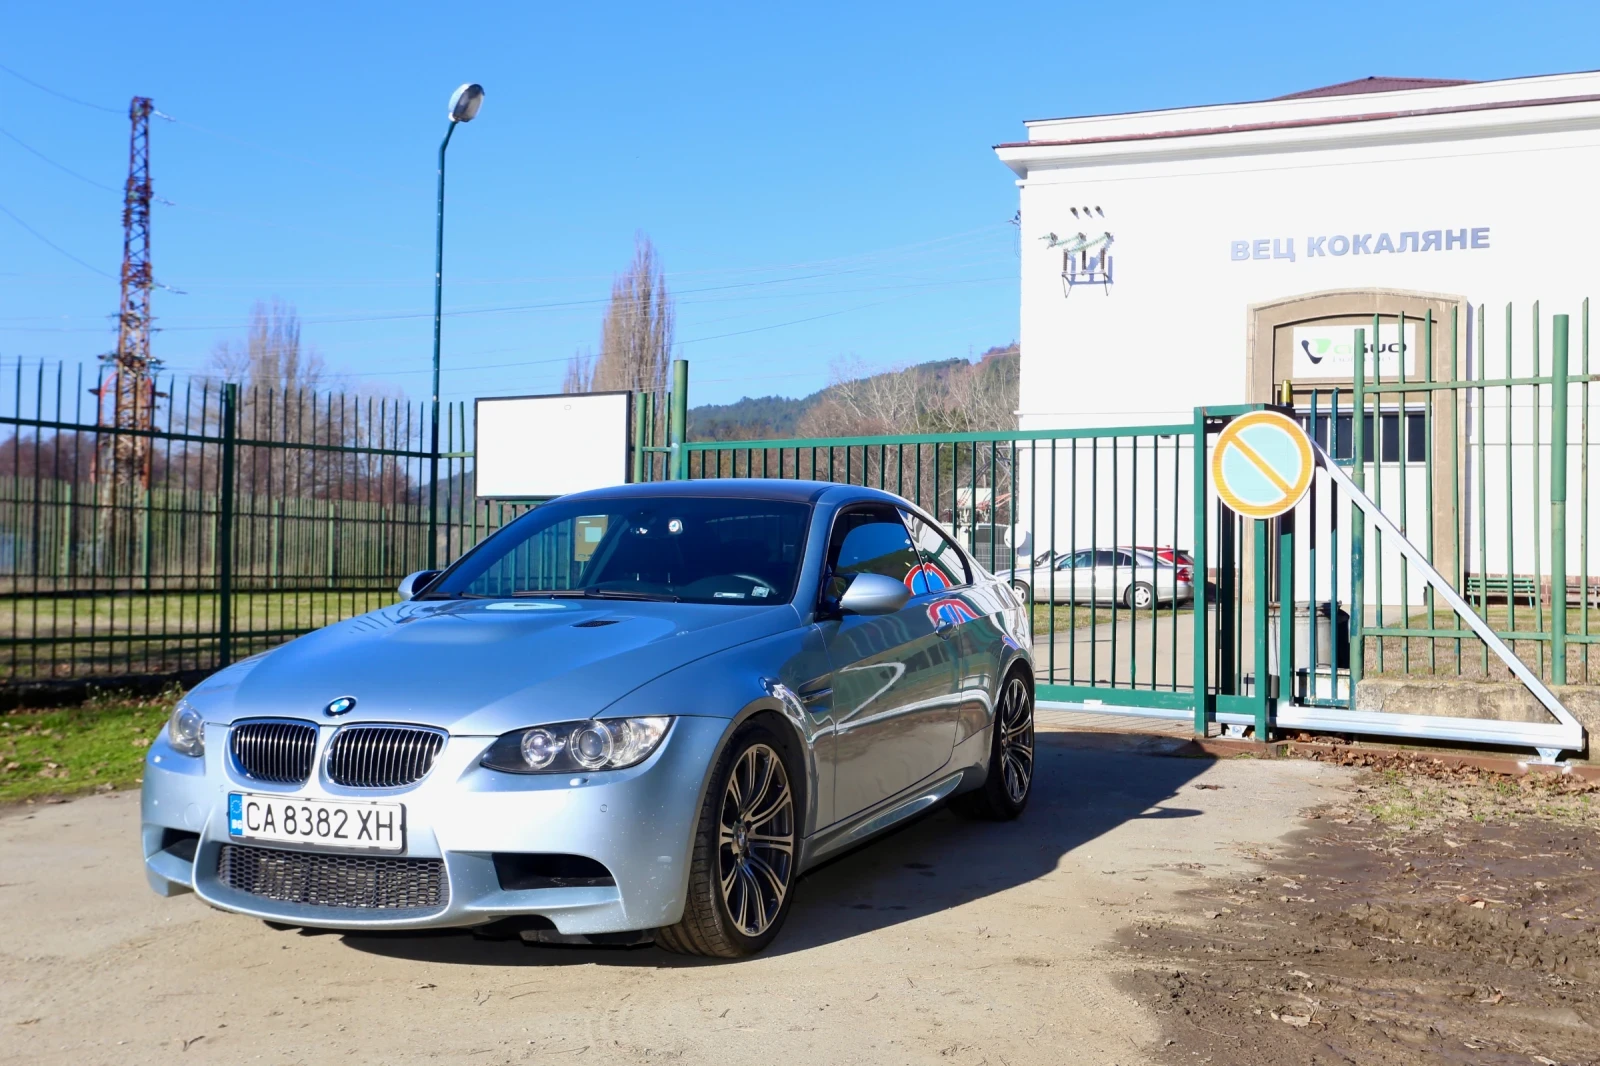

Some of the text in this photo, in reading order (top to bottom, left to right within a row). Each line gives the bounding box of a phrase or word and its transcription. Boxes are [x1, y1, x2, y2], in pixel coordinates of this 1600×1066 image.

[1231, 227, 1490, 262] ВЕЦ КОКАЛЯНЕ
[246, 802, 393, 841] CA 8382 XH
